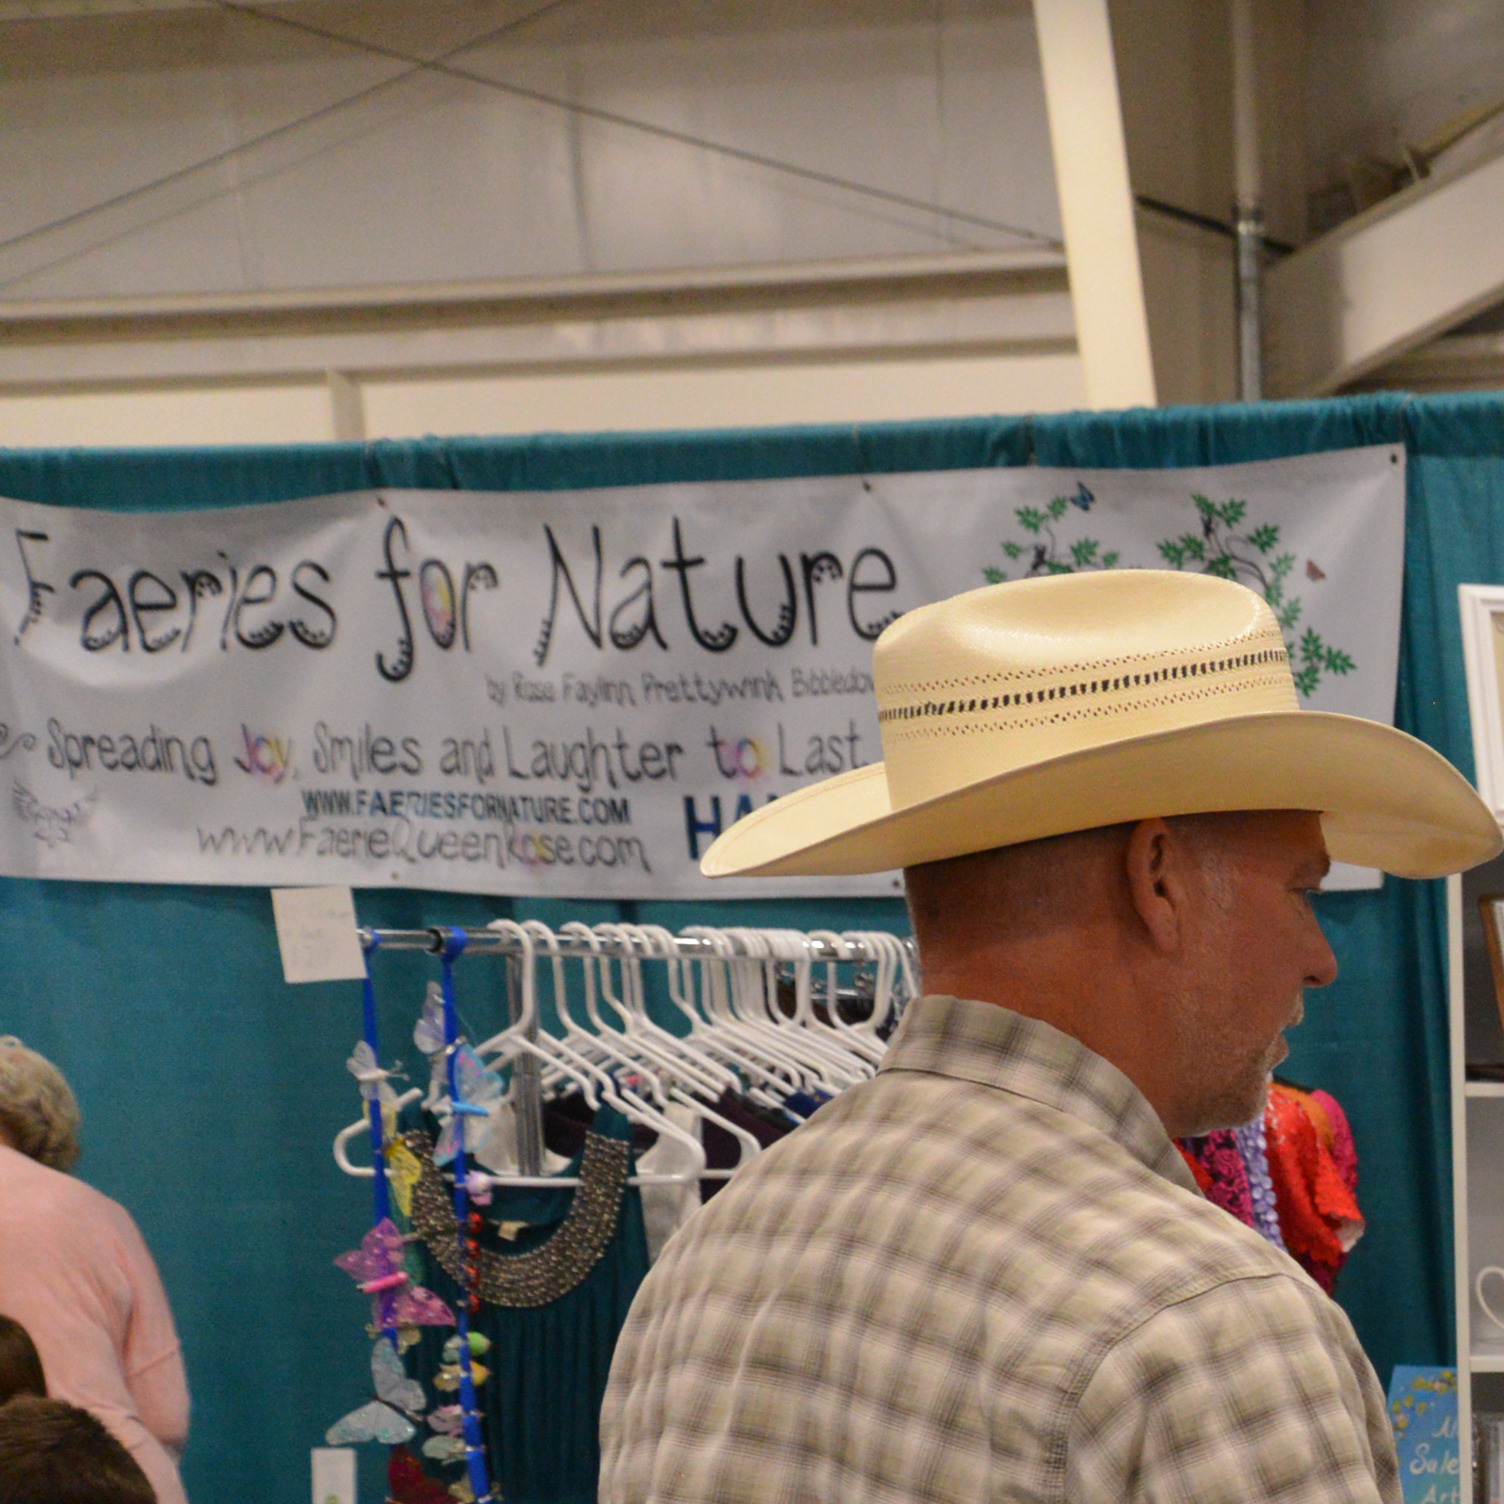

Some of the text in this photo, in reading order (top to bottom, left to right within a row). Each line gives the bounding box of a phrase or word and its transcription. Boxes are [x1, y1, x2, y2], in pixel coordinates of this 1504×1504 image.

[13, 516, 902, 682] Faeries for Nature
[46, 717, 218, 786] Spreading
[313, 720, 423, 783] Smiles
[439, 726, 495, 786] and
[503, 722, 685, 793] Laughter
[705, 724, 763, 782] to
